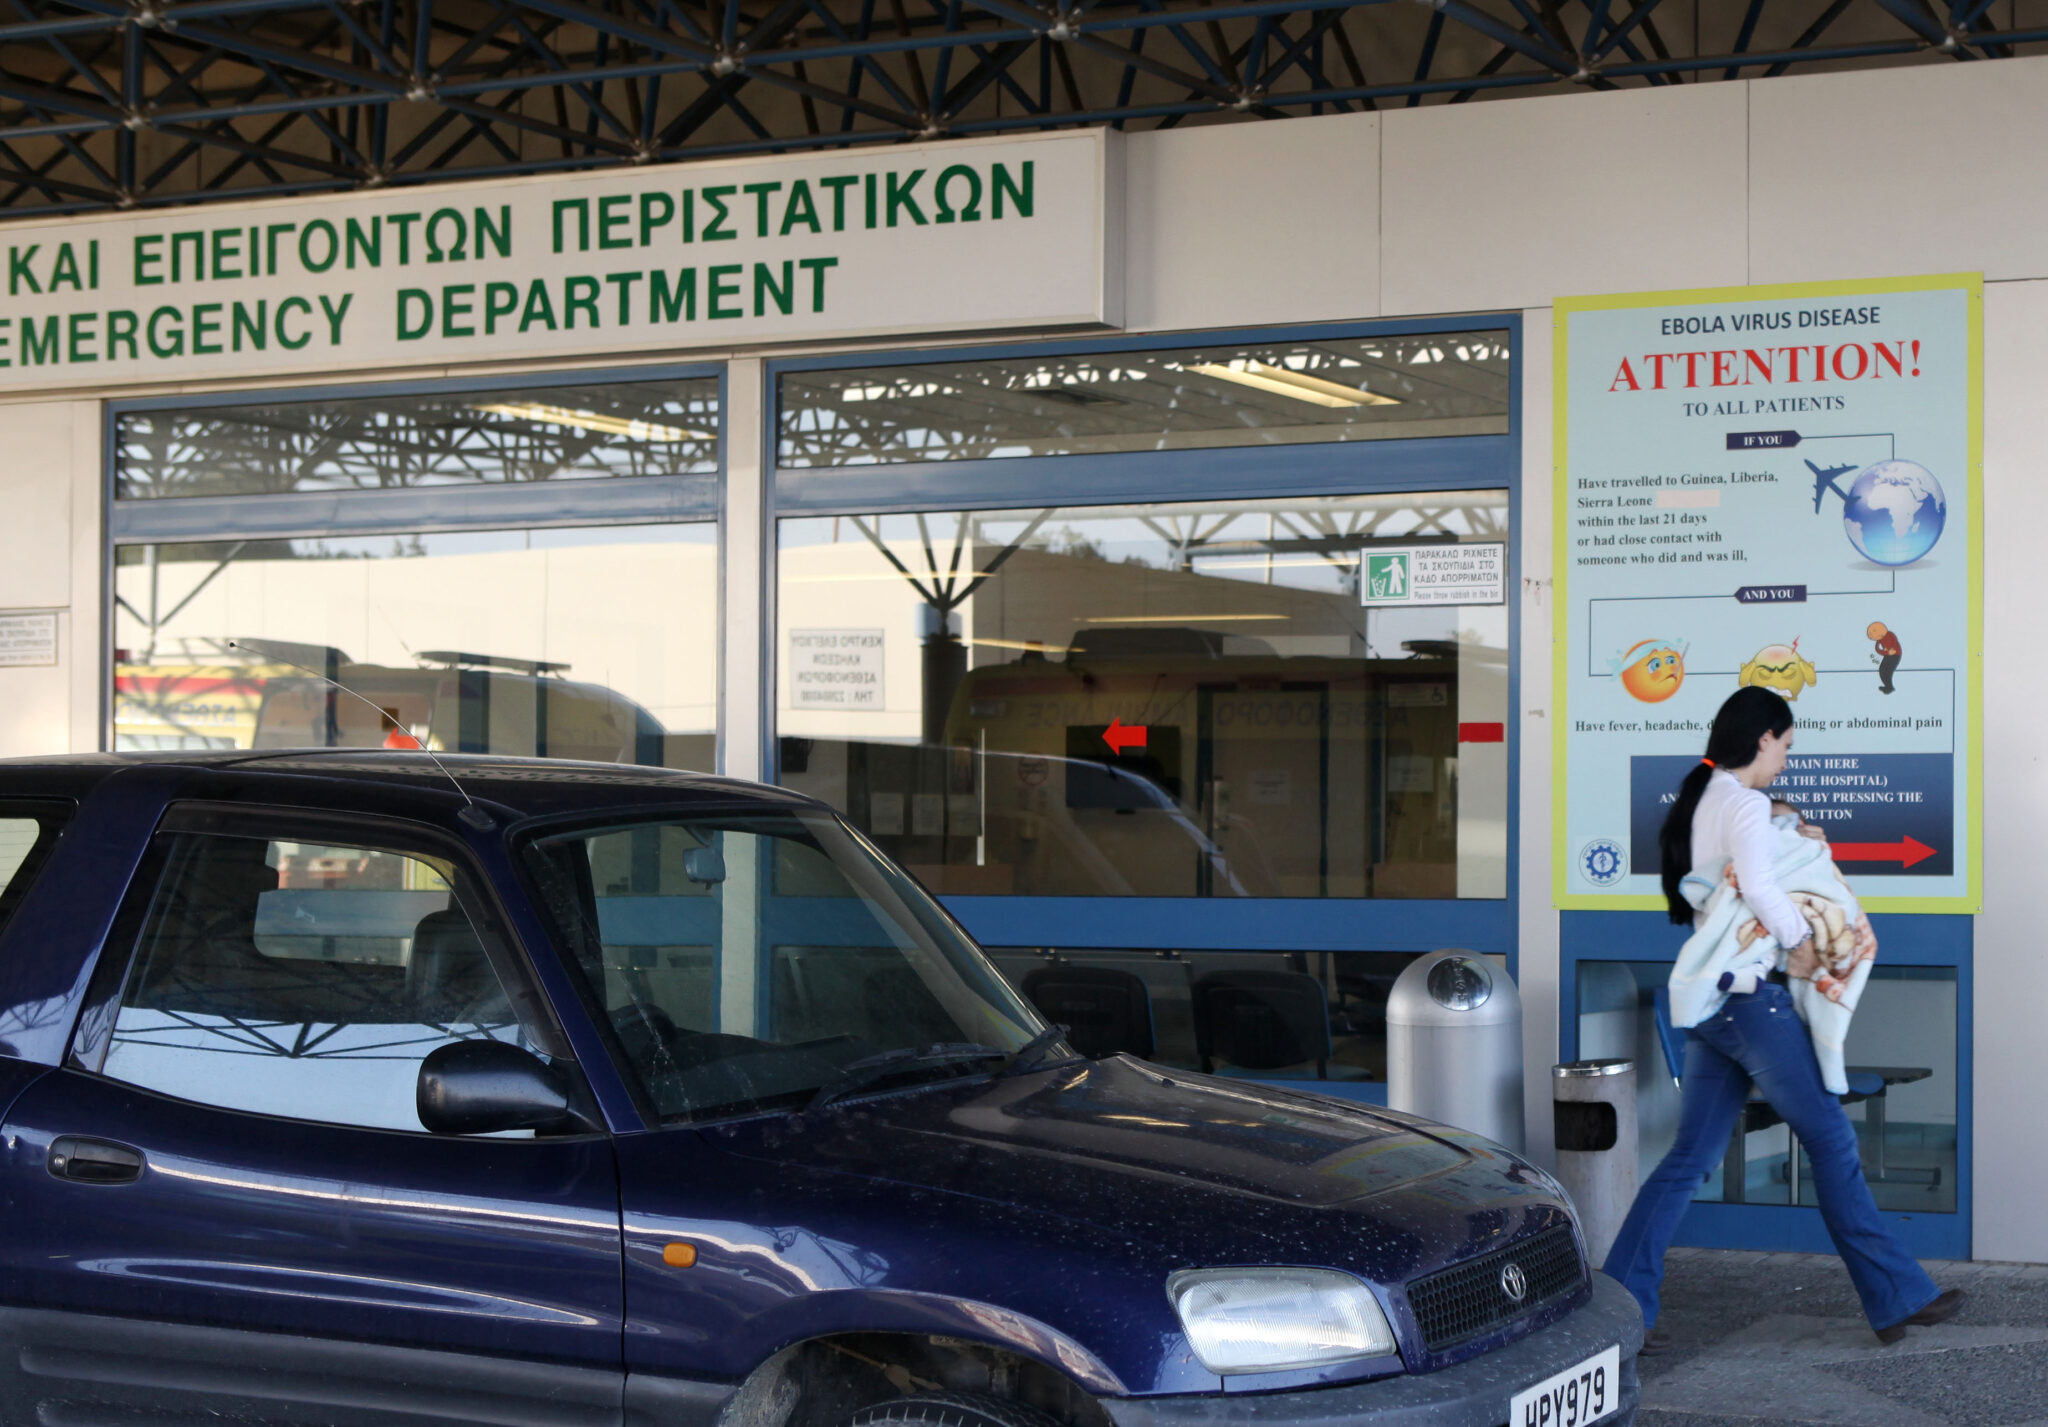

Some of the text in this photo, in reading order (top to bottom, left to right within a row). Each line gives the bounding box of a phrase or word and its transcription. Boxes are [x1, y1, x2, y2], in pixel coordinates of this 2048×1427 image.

[9, 160, 1034, 296] ΚΑΙ ΕΠΕΙΓΟΝΤΩΝ ΠΕΡΙΣΤΑΤΙΚΩΝ
[397, 257, 838, 340] DEPARTMENT
[1662, 306, 1880, 335] EBOLA VIRUS DISEASE
[1608, 339, 1921, 392] ATTENTION!
[1683, 395, 1845, 417] TO ALL PATIENTS
[1743, 435, 1783, 446] IF YOU
[1578, 470, 1778, 489] Have travelled to Guinea, Liberia,
[1577, 496, 1652, 509] Sierra Leone
[1577, 513, 1707, 527] within the last 21 days
[1577, 531, 1722, 547] or had close contact with
[1415, 548, 1497, 559] ΠΑΡΑΚΑΛΩ ΡΙΧΝΕΤΕ
[1577, 556, 1627, 566] someone
[1630, 553, 1654, 564] who
[1658, 552, 1677, 563] did
[1681, 551, 1702, 563] and
[1706, 552, 1729, 561] was
[1418, 561, 1494, 571] ΤΑ ΣΚΟΥΠΙΔΙΑ ΣΤΟ
[1414, 574, 1437, 583] ΚΑΔΟ
[1743, 589, 1795, 600] AND YOU
[1575, 720, 1606, 732] Have
[1608, 720, 1641, 732] fever,
[1645, 719, 1704, 731] headache,
[1830, 719, 1843, 729] or
[1847, 717, 1912, 729] abdominal
[1915, 717, 1943, 731] pain
[1824, 758, 1859, 769] HERE
[1792, 775, 1817, 786] THE
[1820, 775, 1888, 787] HOSPITAL)
[1813, 792, 1830, 802] BY
[1833, 791, 1894, 803] PRESSING
[1897, 791, 1923, 802] THE
[1801, 809, 1853, 820] BUTTON
